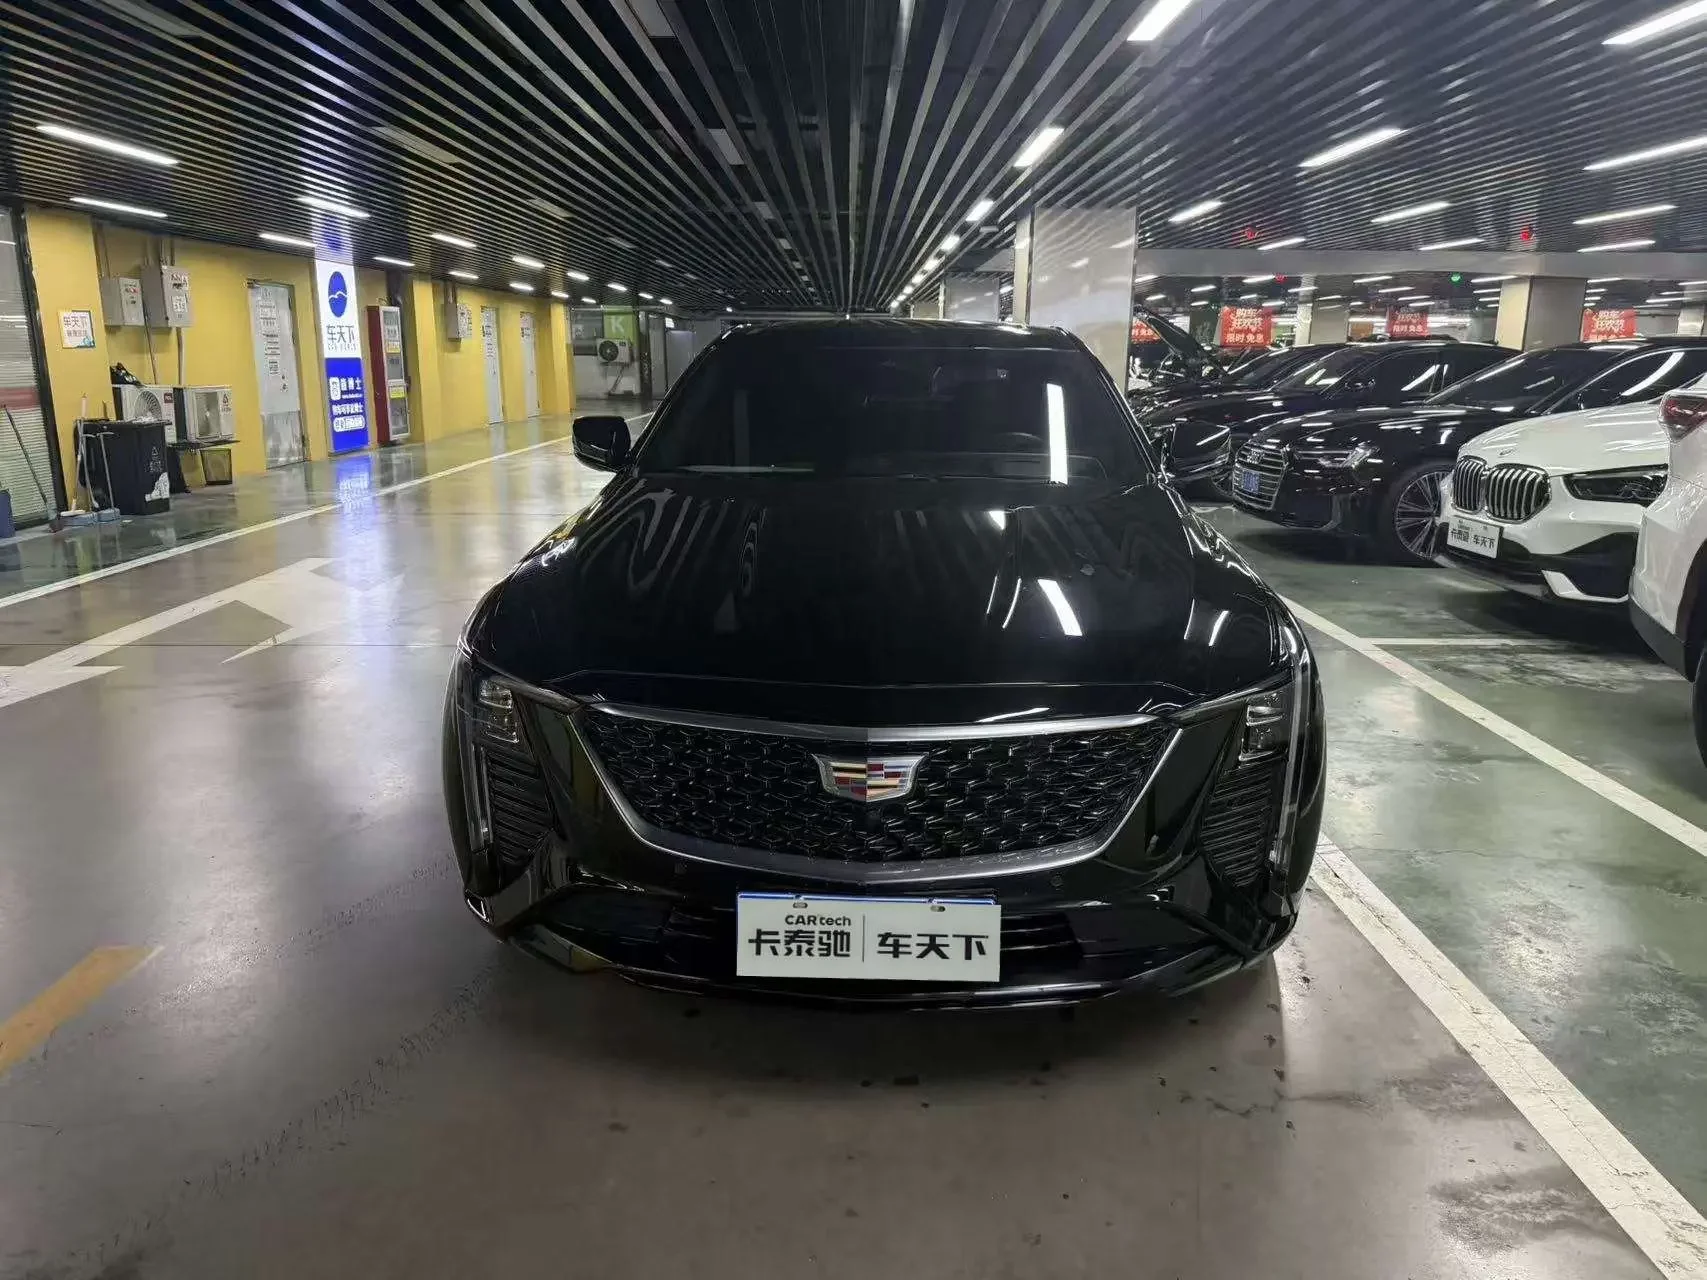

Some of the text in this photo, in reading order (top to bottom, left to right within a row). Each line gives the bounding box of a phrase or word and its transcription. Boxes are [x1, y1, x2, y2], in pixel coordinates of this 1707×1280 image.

[326, 324, 355, 343] 车天下
[748, 928, 989, 960] 卡泰驰 车天下
